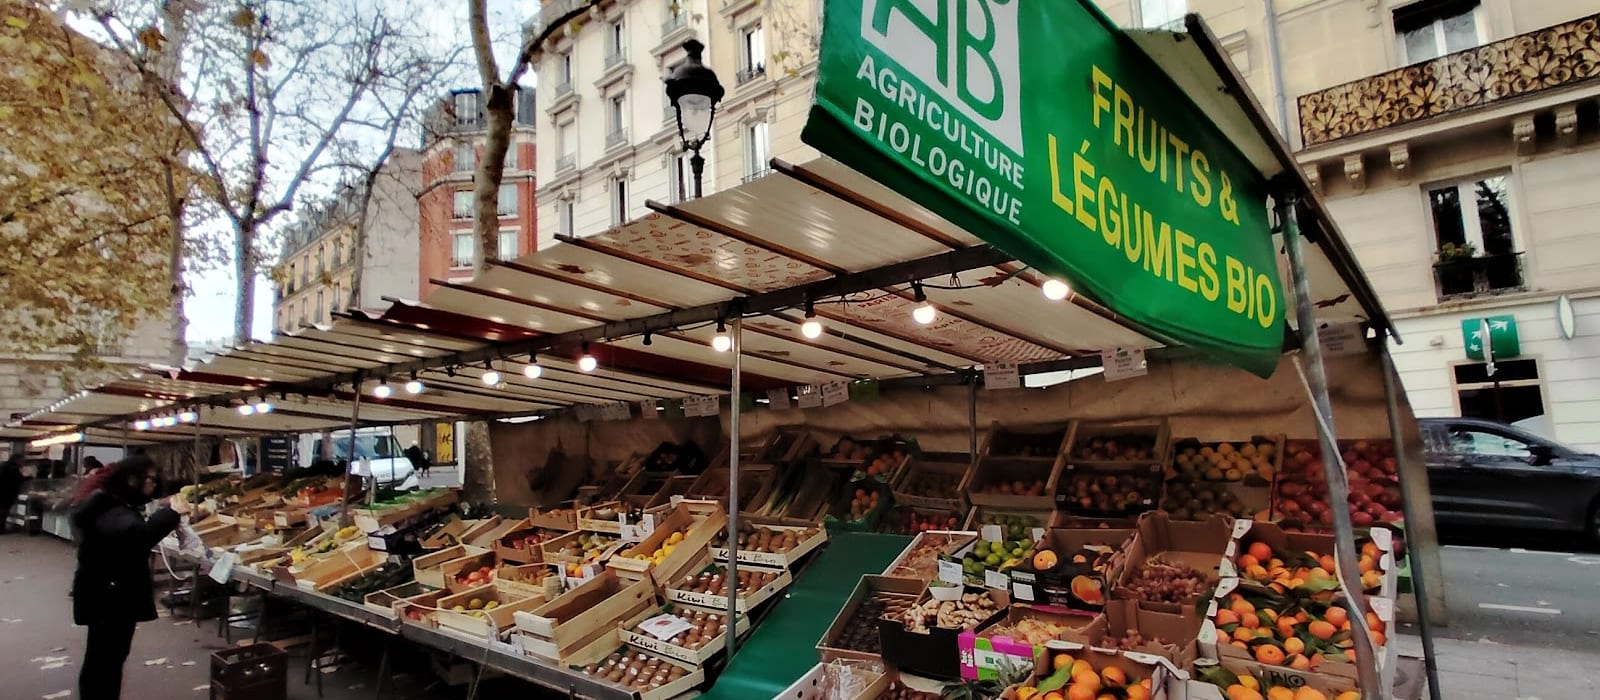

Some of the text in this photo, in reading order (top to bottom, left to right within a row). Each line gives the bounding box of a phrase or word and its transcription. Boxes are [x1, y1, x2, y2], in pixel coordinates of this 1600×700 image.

[854, 97, 1023, 226] BIOLOGIQUE
[856, 54, 1025, 190] AGRICULTURE
[1092, 64, 1240, 226] FRUITS &
[1048, 133, 1276, 328] LÉGUMES BIO
[629, 634, 659, 650] Kiwi
[676, 591, 705, 604] Kiwi
